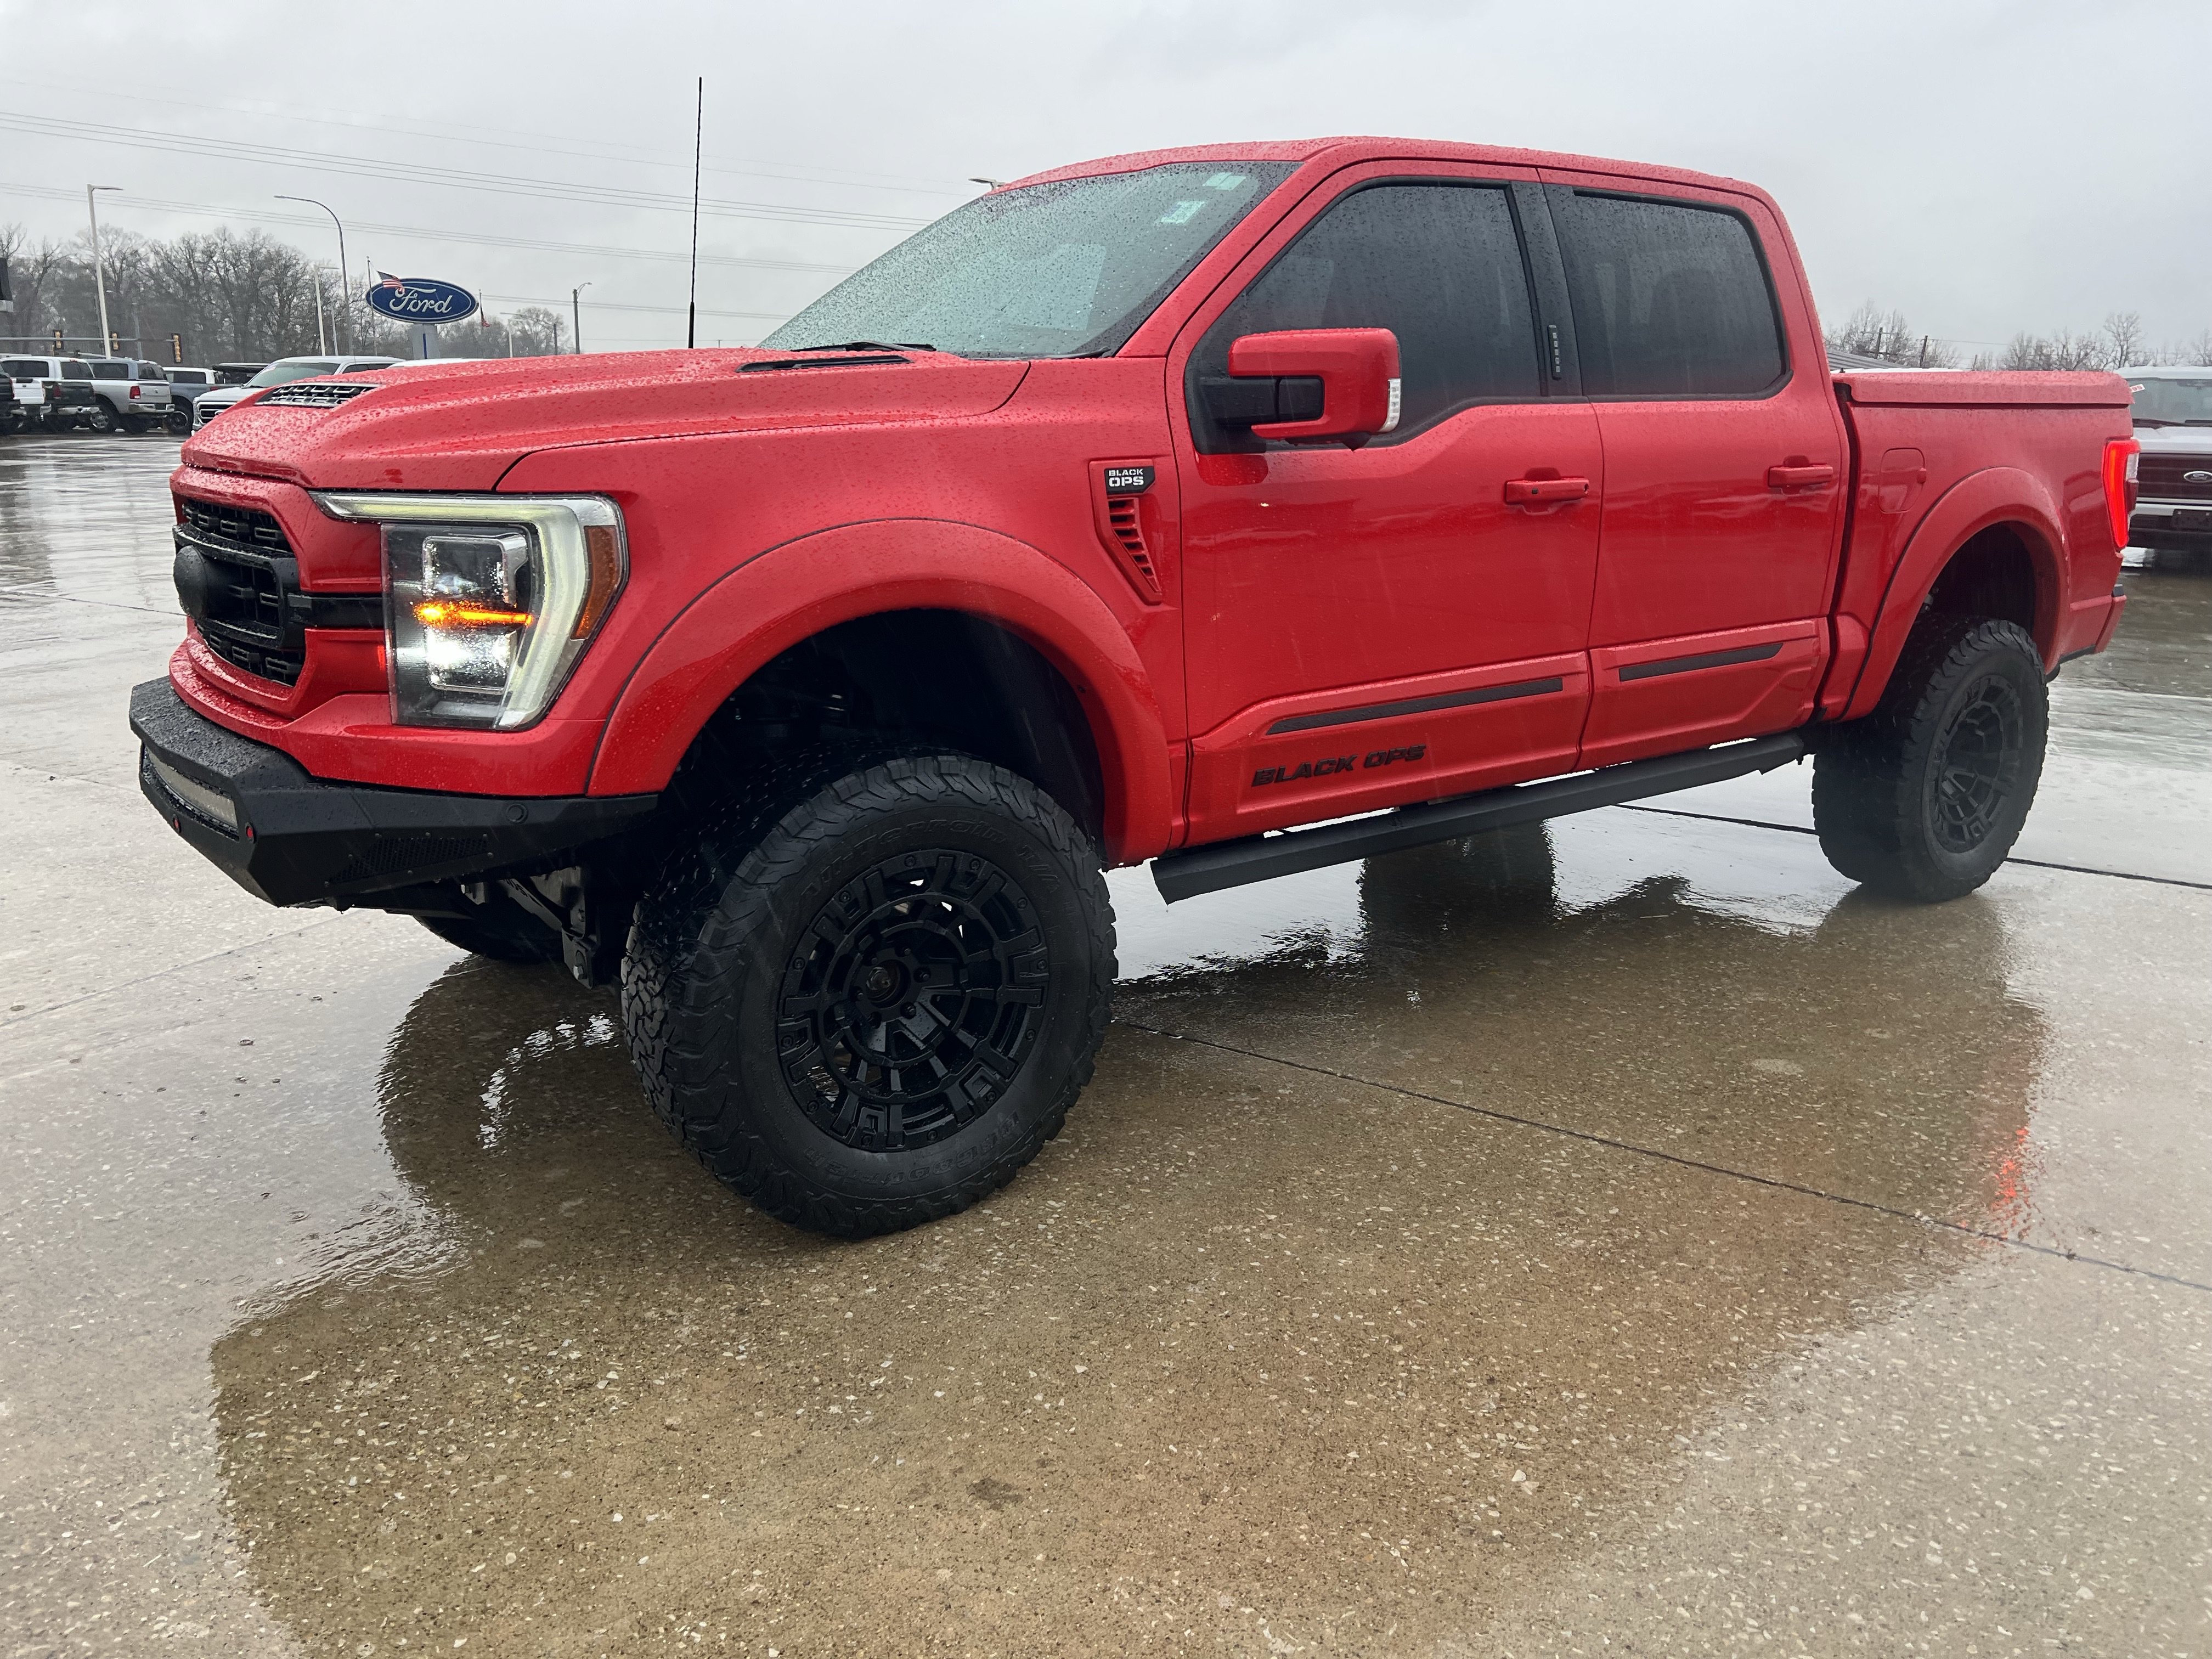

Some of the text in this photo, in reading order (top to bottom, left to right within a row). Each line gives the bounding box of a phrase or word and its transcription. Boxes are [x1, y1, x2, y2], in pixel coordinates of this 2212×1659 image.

[390, 286, 453, 313] Ford
[1109, 476, 1144, 487] OPS
[1251, 744, 1427, 787] BLACK OPS
